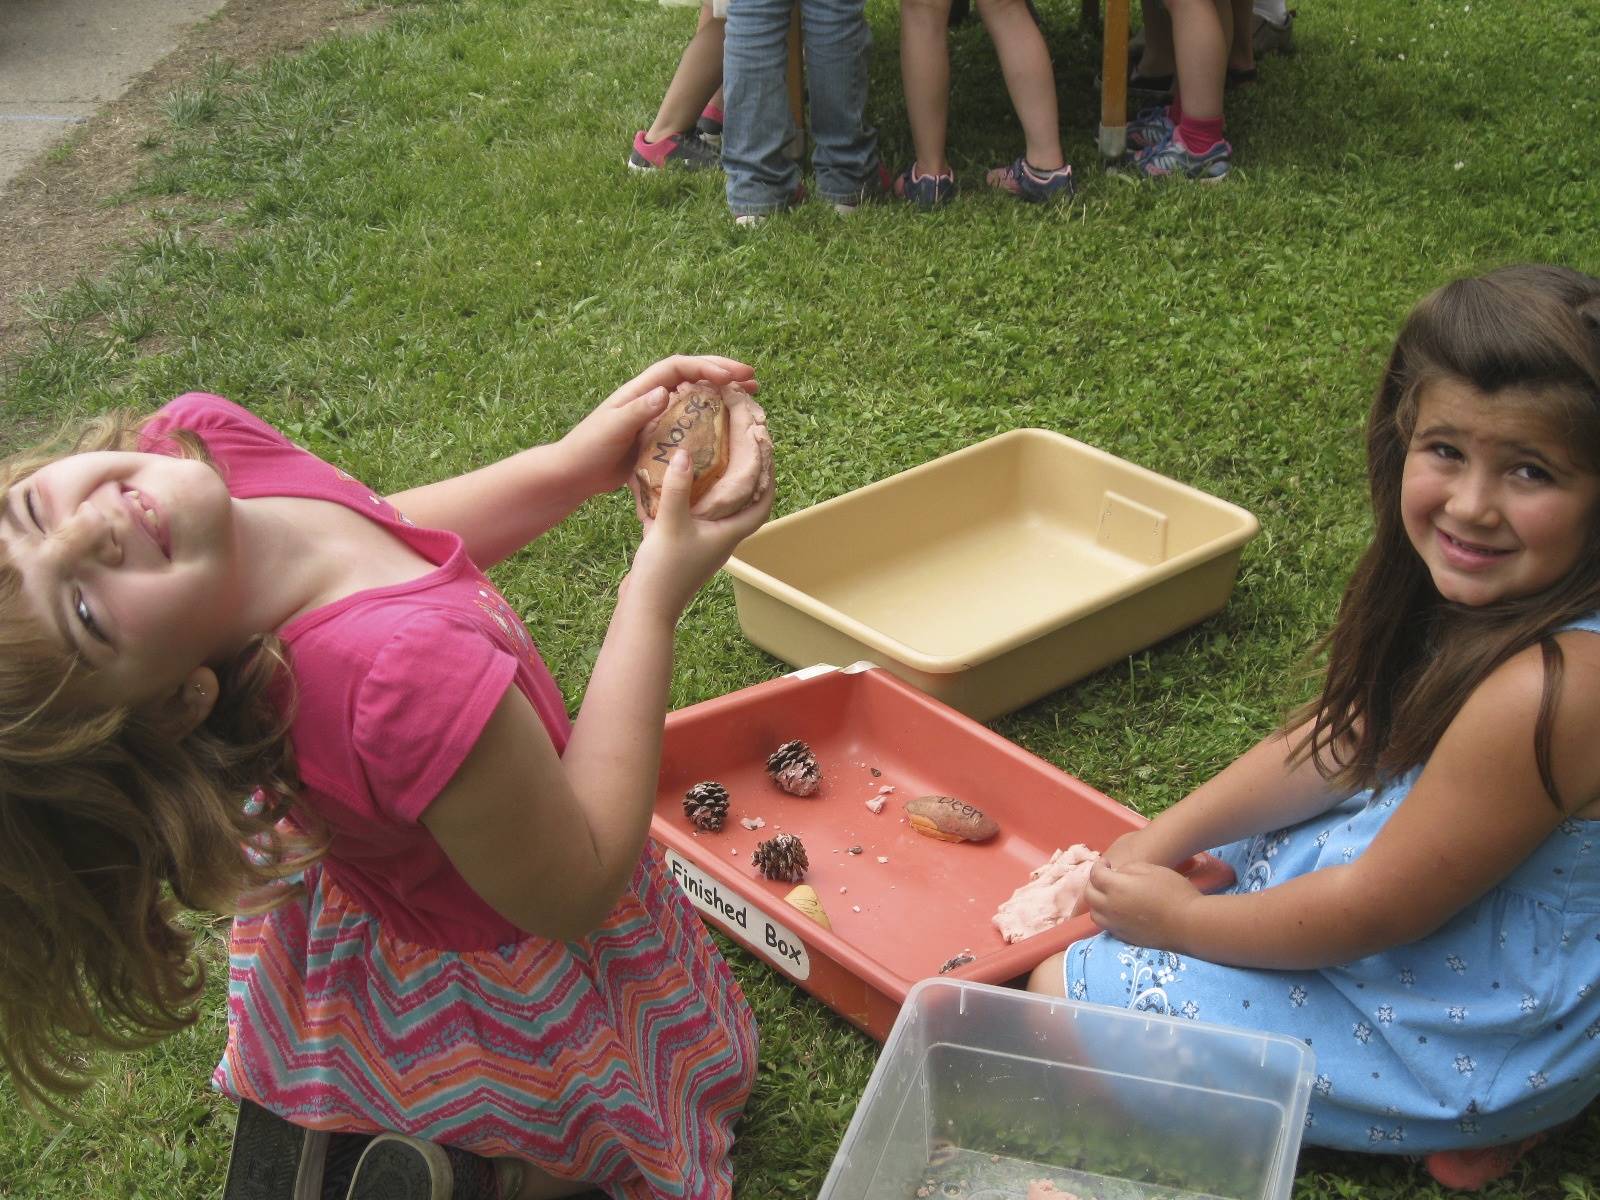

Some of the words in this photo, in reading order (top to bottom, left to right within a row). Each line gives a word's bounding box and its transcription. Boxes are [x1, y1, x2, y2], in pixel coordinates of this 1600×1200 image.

[652, 395, 709, 465] Moose
[672, 859, 747, 929] Finished
[765, 922, 802, 966] Box
